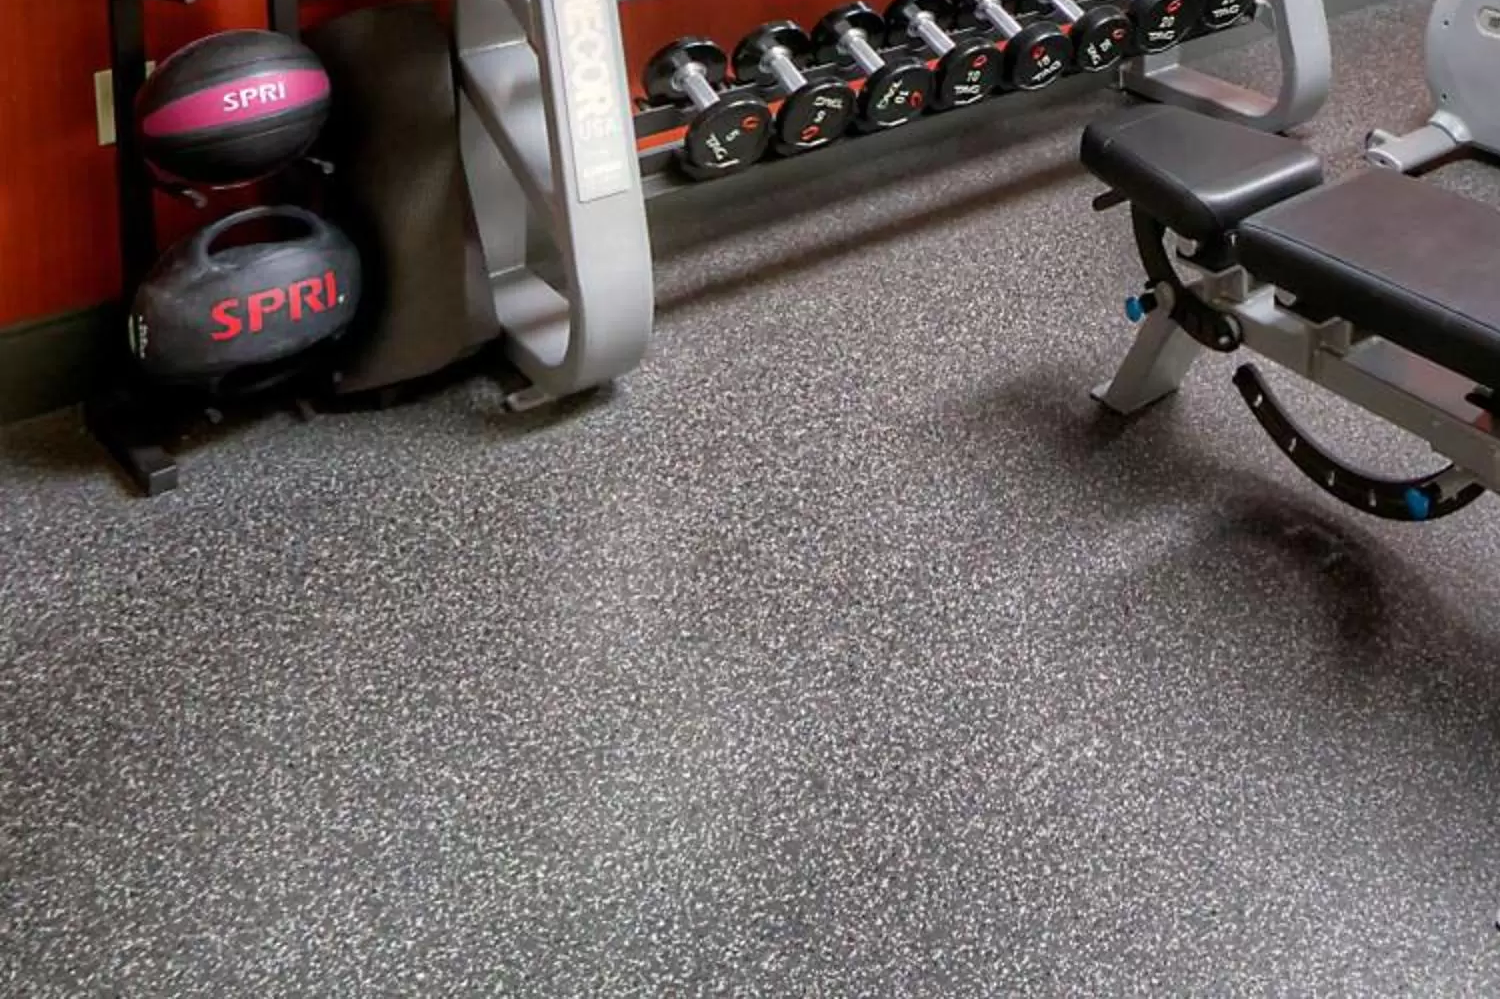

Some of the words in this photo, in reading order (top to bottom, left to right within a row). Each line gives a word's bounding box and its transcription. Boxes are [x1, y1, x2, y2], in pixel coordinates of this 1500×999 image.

[1211, 4, 1240, 18] TAG
[223, 81, 286, 112] SPRI
[813, 96, 844, 109] TAG
[876, 80, 903, 110] TAG
[953, 84, 981, 95] TAG
[705, 133, 729, 161] TAG
[210, 272, 338, 342] SPRI
